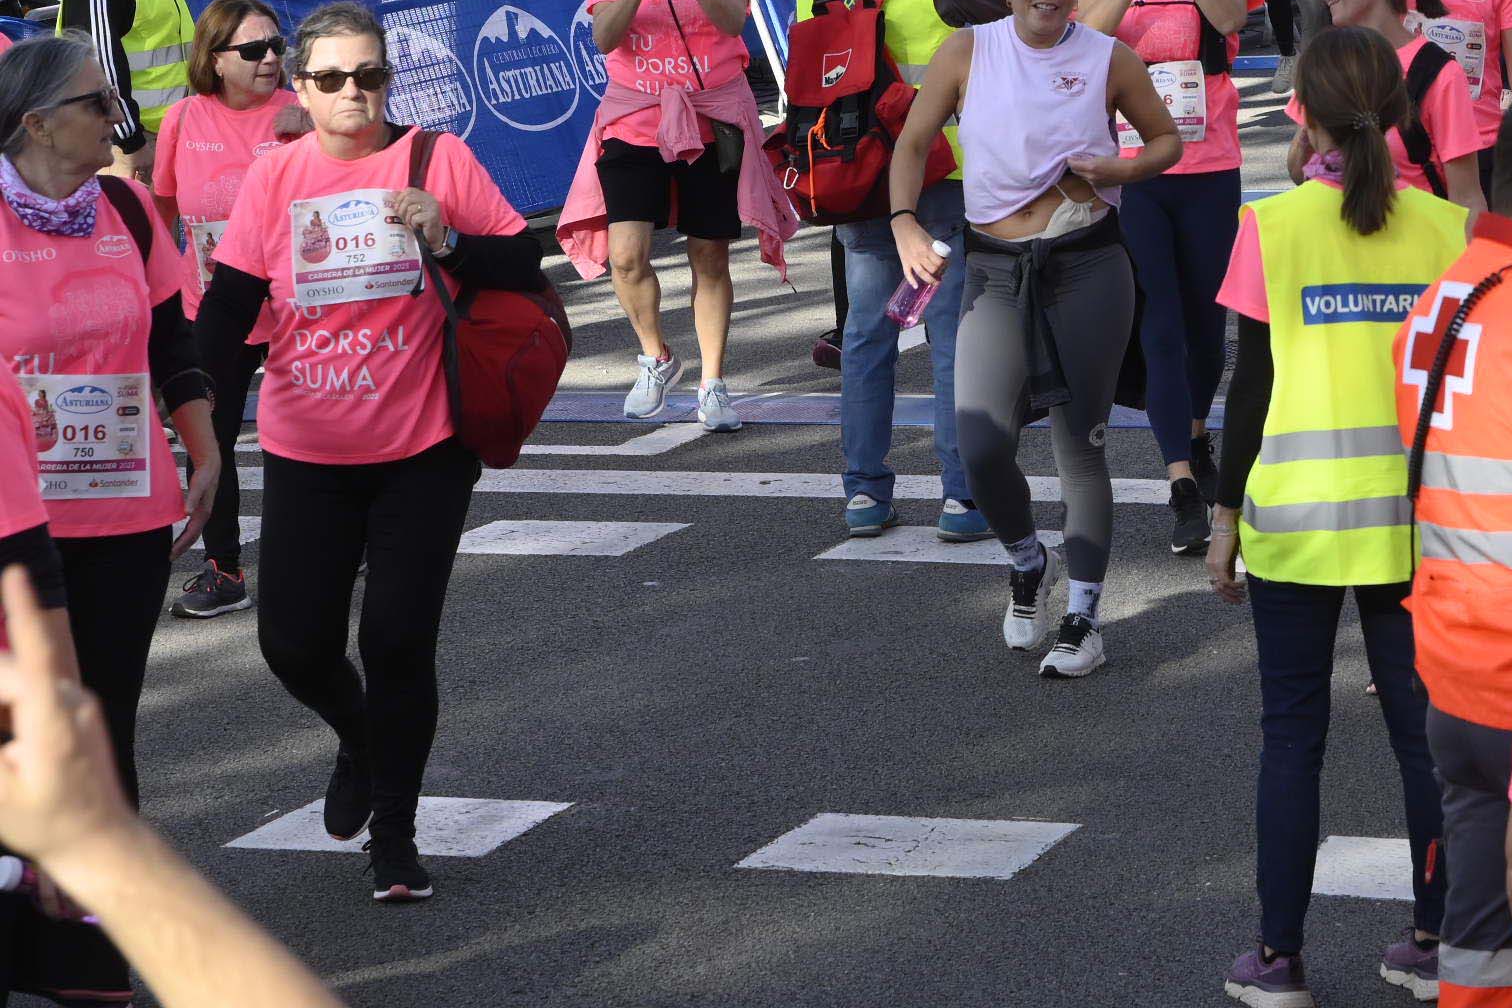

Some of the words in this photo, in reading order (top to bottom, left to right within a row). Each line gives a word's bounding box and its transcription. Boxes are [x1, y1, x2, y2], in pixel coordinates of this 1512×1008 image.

[629, 34, 652, 51] TU
[493, 47, 527, 64] CENTRAL
[528, 43, 560, 59] LECHERA
[635, 55, 711, 74] DORSAL
[483, 57, 576, 105] ASTURIANA
[186, 141, 224, 152] OYSHO
[335, 233, 376, 251] 016
[3, 247, 56, 263] OYSHO
[346, 254, 366, 264] 752
[308, 270, 341, 280] CARRERA
[366, 265, 391, 274] MUJER
[307, 285, 344, 298] OYSHO
[375, 278, 416, 289] Santander
[1306, 293, 1420, 315] VOLUNTARI
[294, 325, 409, 355] DORSAL
[291, 360, 377, 392] SUMA
[61, 396, 109, 408] ASTURIANA
[62, 424, 106, 442] 016
[73, 447, 94, 458] 750
